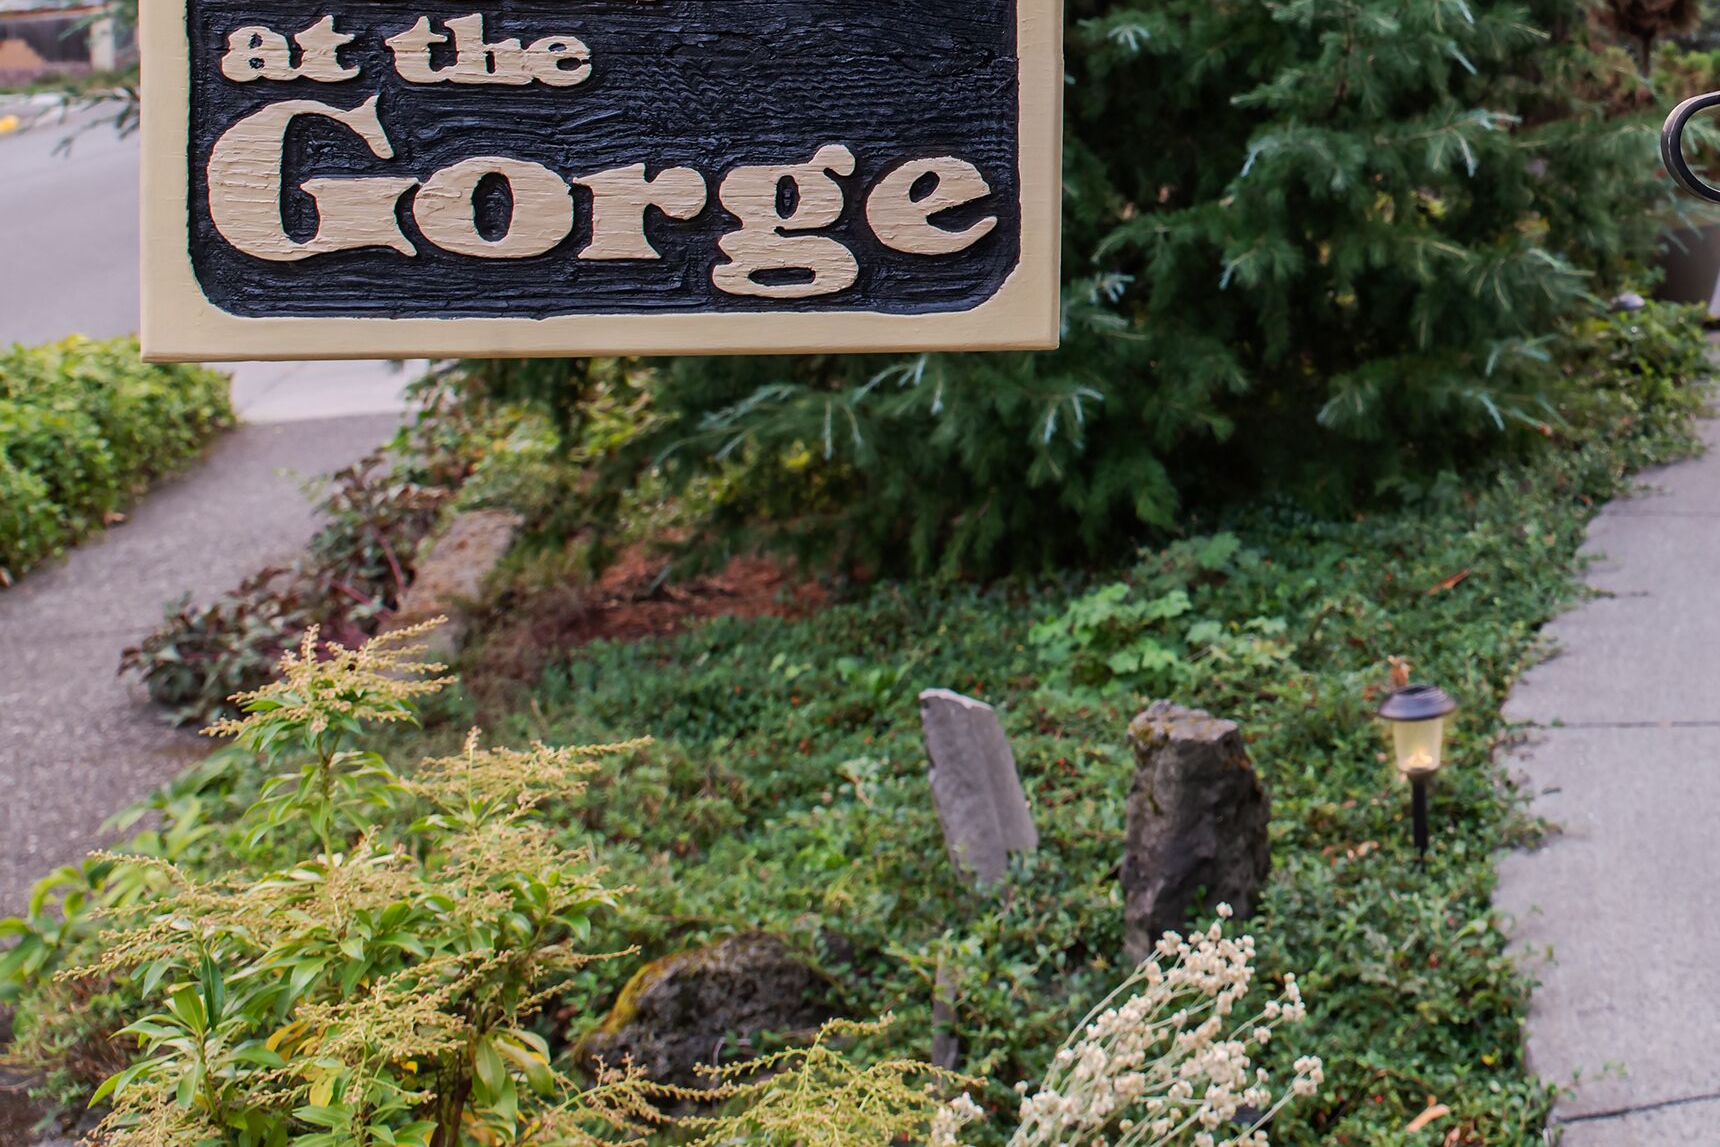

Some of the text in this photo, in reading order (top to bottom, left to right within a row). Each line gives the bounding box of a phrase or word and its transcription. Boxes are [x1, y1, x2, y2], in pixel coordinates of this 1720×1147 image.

[221, 12, 593, 87] at the
[206, 94, 998, 298] Gorge
